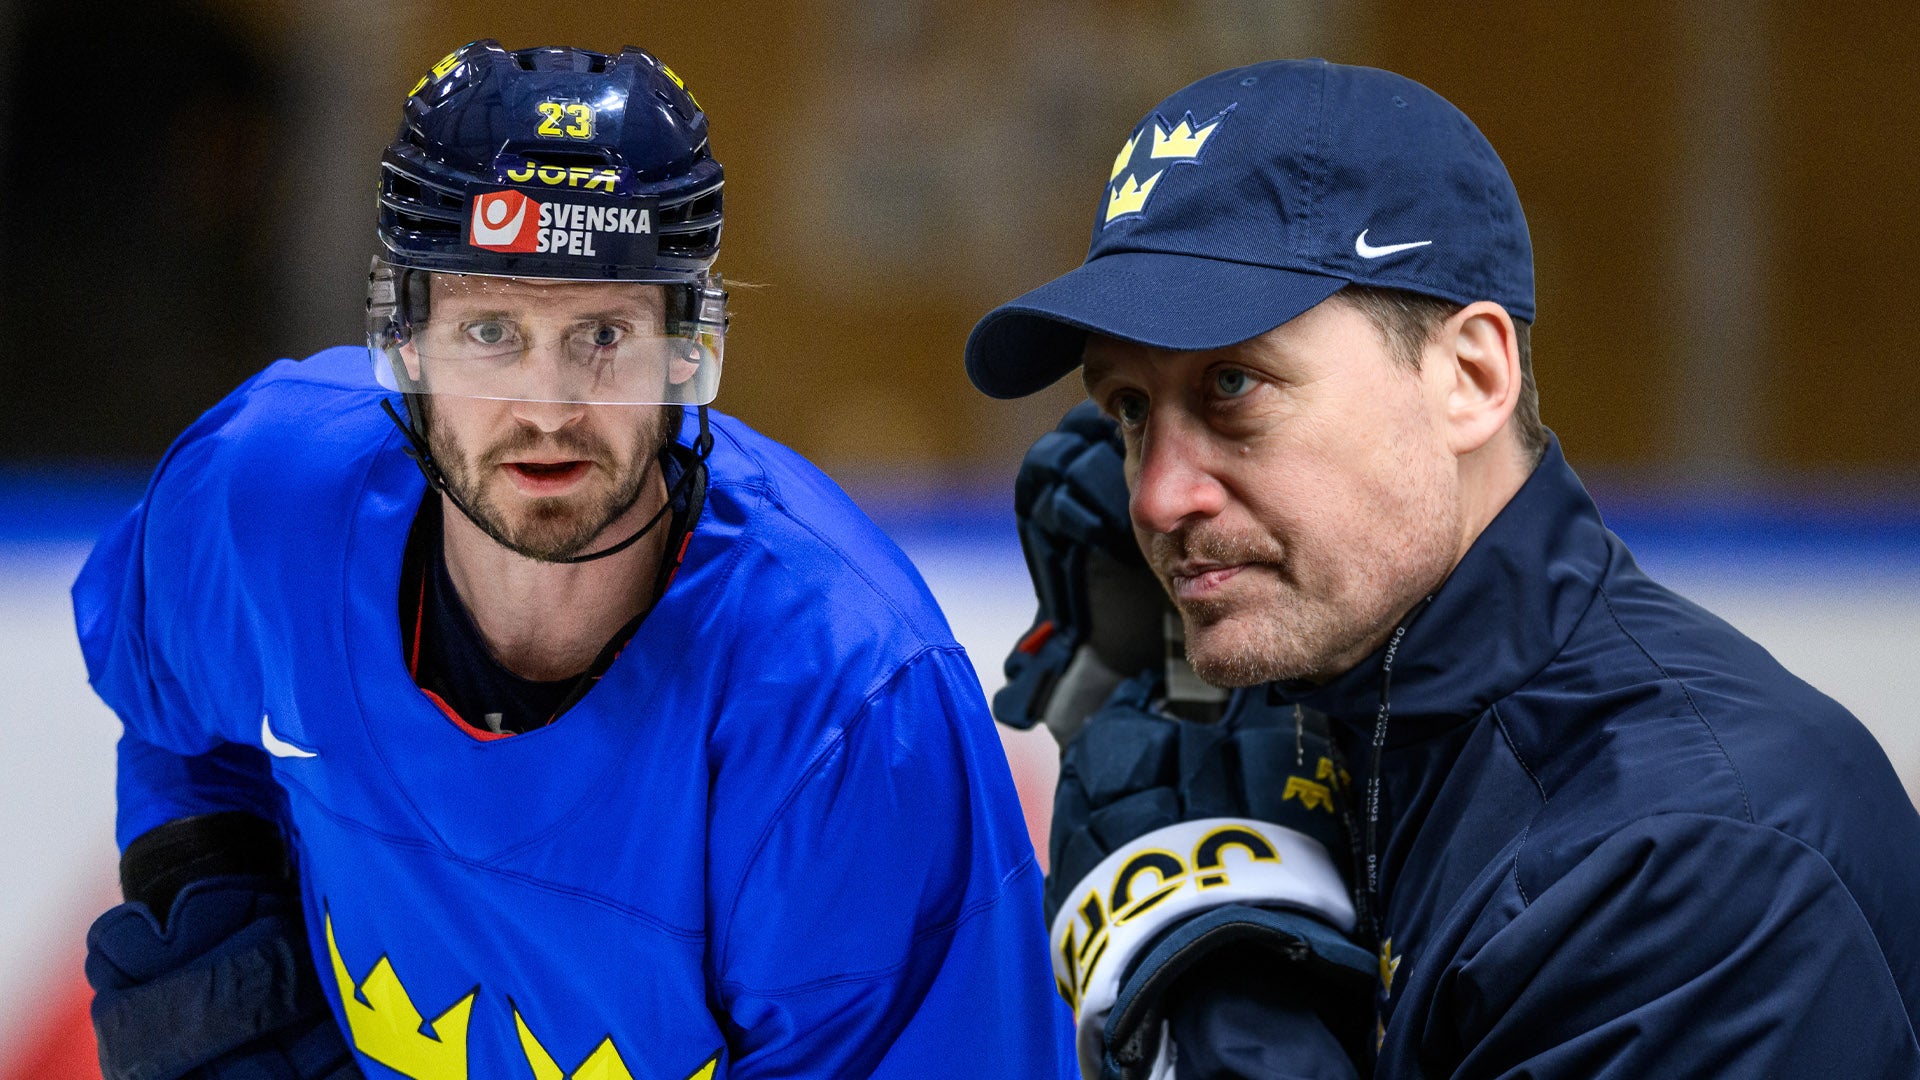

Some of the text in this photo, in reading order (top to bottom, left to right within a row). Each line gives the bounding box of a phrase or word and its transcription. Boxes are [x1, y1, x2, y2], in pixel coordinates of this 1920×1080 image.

[537, 102, 592, 139] 23
[507, 161, 620, 192] JOFA
[538, 202, 651, 234] SVENSKA
[536, 228, 595, 256] SPEL
[1383, 627, 1405, 671] FOX40
